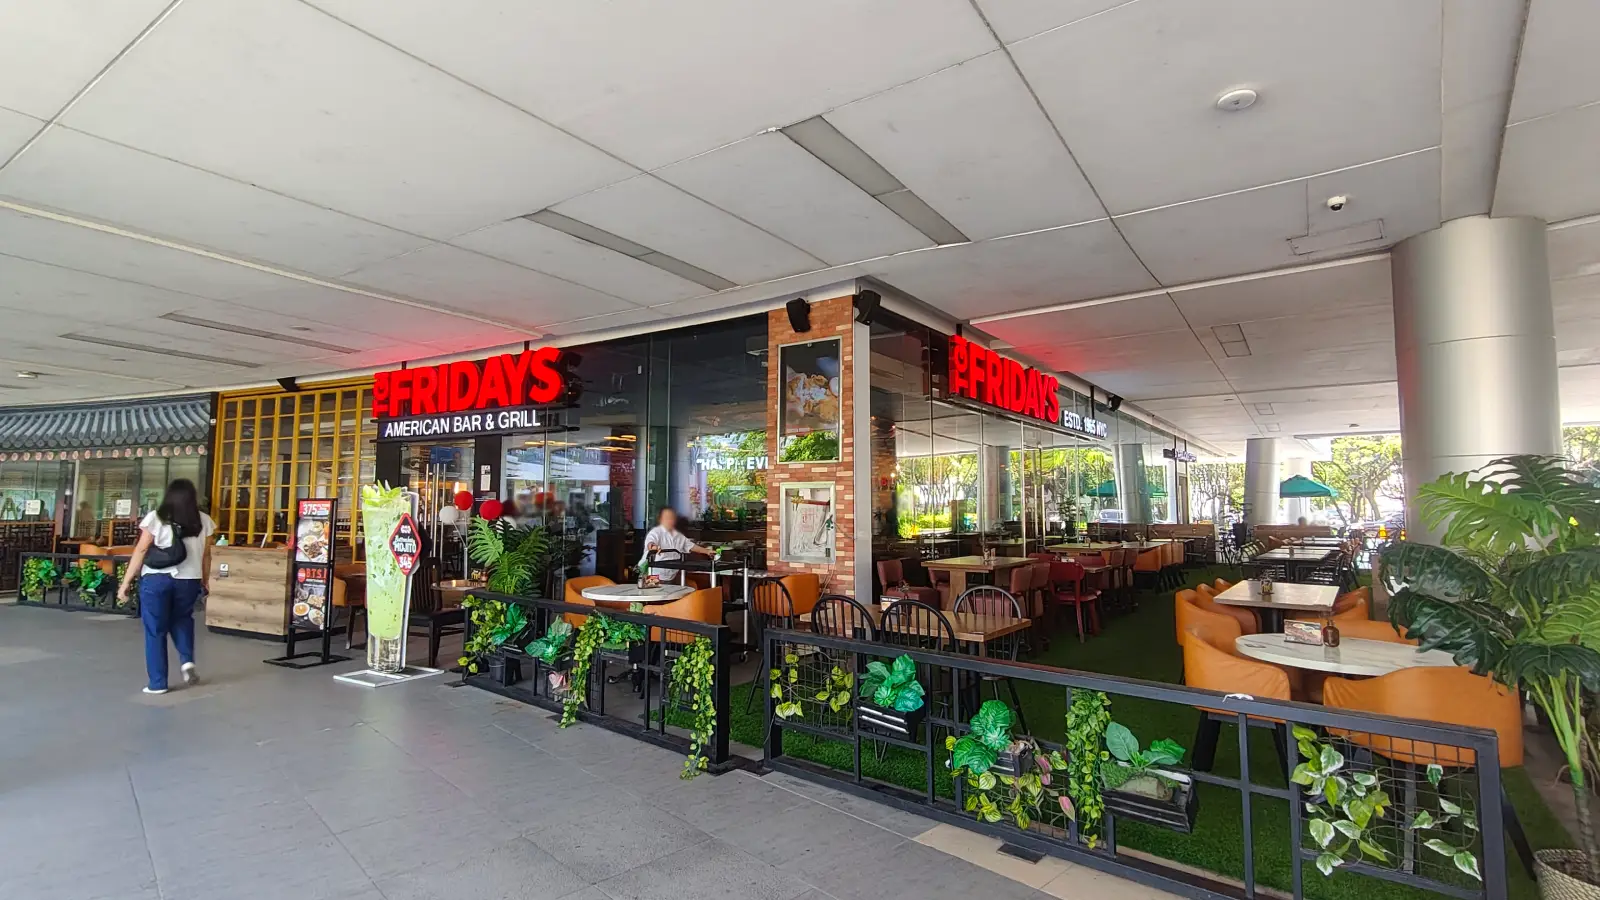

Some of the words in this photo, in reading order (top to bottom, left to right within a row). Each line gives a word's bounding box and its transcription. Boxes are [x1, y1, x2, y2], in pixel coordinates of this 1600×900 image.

[372, 372, 390, 419] TGI
[389, 346, 565, 417] FRIDAYS
[950, 334, 969, 394] TGI
[969, 342, 1060, 424] FRIDAYS
[384, 417, 450, 438] AMERICAN
[453, 414, 482, 432] BAR
[485, 413, 495, 430] &
[498, 409, 541, 428] GRILL
[1064, 410, 1083, 430] ESTD.
[303, 503, 318, 516] 375
[393, 541, 417, 553] MOJITO
[399, 555, 412, 569] 345
